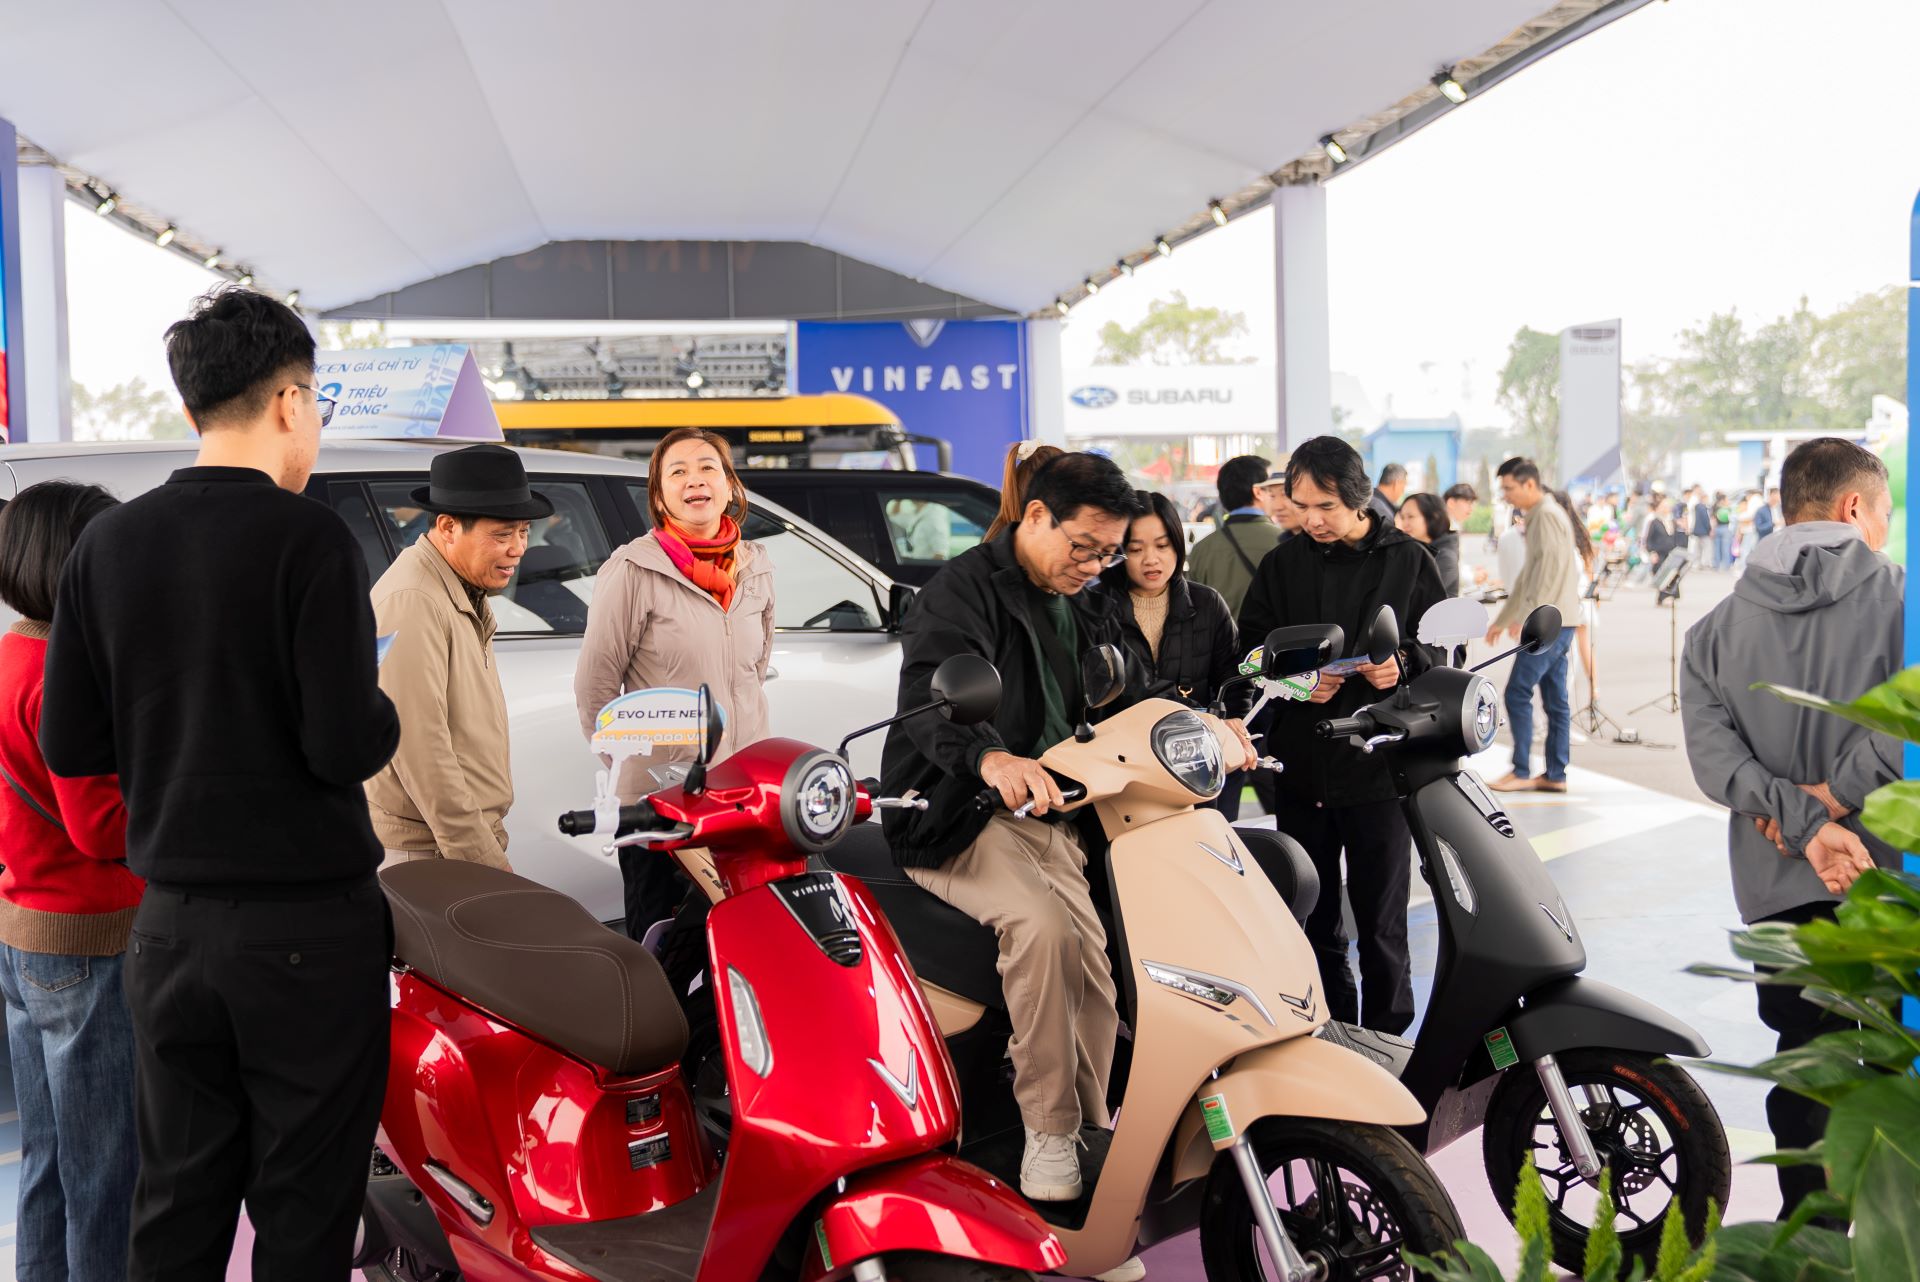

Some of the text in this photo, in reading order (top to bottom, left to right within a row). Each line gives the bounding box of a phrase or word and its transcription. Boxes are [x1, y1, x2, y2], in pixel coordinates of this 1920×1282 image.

[353, 359, 375, 372] GIÁ
[402, 356, 422, 371] TỪ
[830, 364, 1018, 392] VINFAST
[348, 384, 389, 401] TRIỆU
[1127, 388, 1233, 405] SUBARU
[784, 429, 804, 442] BUS
[617, 710, 645, 719] EVO
[648, 710, 676, 719] LITE
